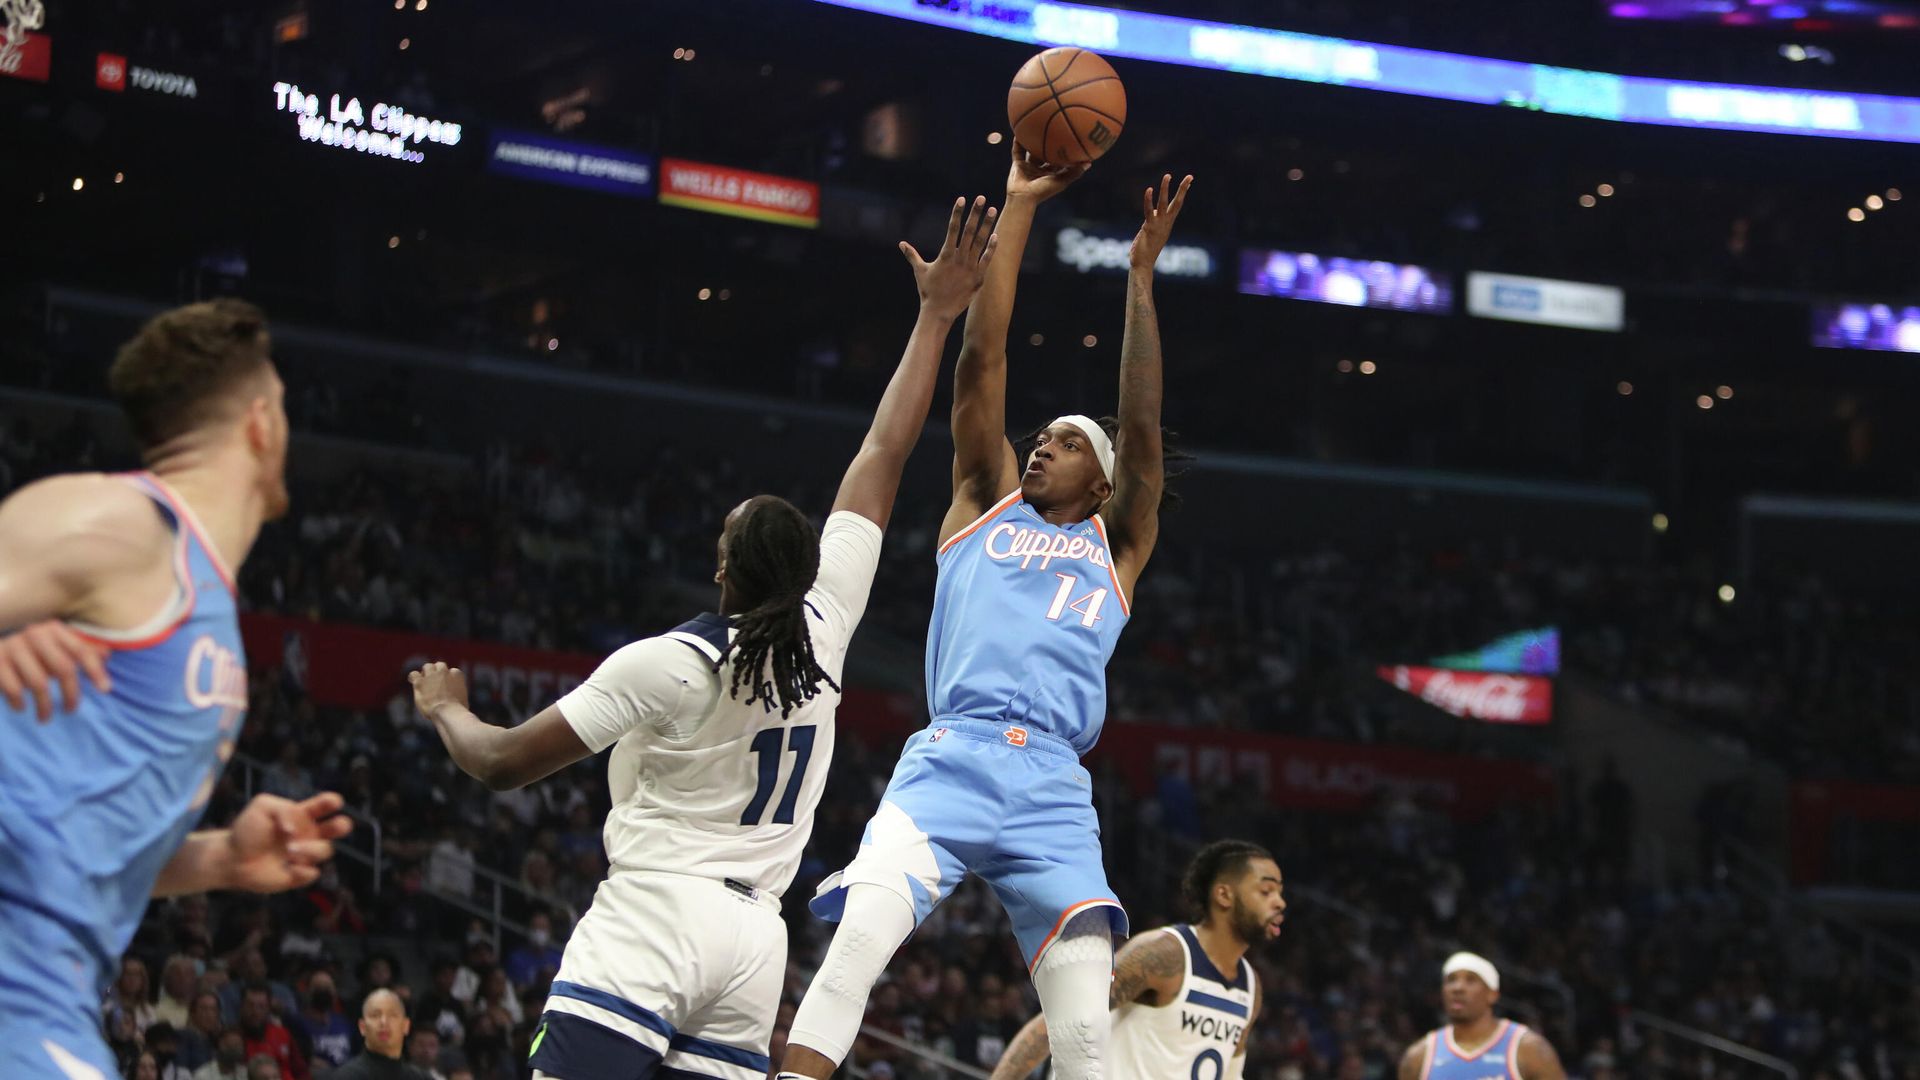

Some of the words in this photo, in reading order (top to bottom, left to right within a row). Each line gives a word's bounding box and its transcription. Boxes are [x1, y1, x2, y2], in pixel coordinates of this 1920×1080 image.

[130, 65, 197, 99] TOYOTA
[273, 81, 319, 116] The
[330, 93, 364, 126] LA
[670, 167, 740, 201] WELLS
[985, 522, 1110, 571] Clippers
[1045, 571, 1109, 629] 14
[739, 724, 817, 826] 11
[1181, 1009, 1242, 1046] WOLVE
[1190, 1047, 1224, 1080] 0
